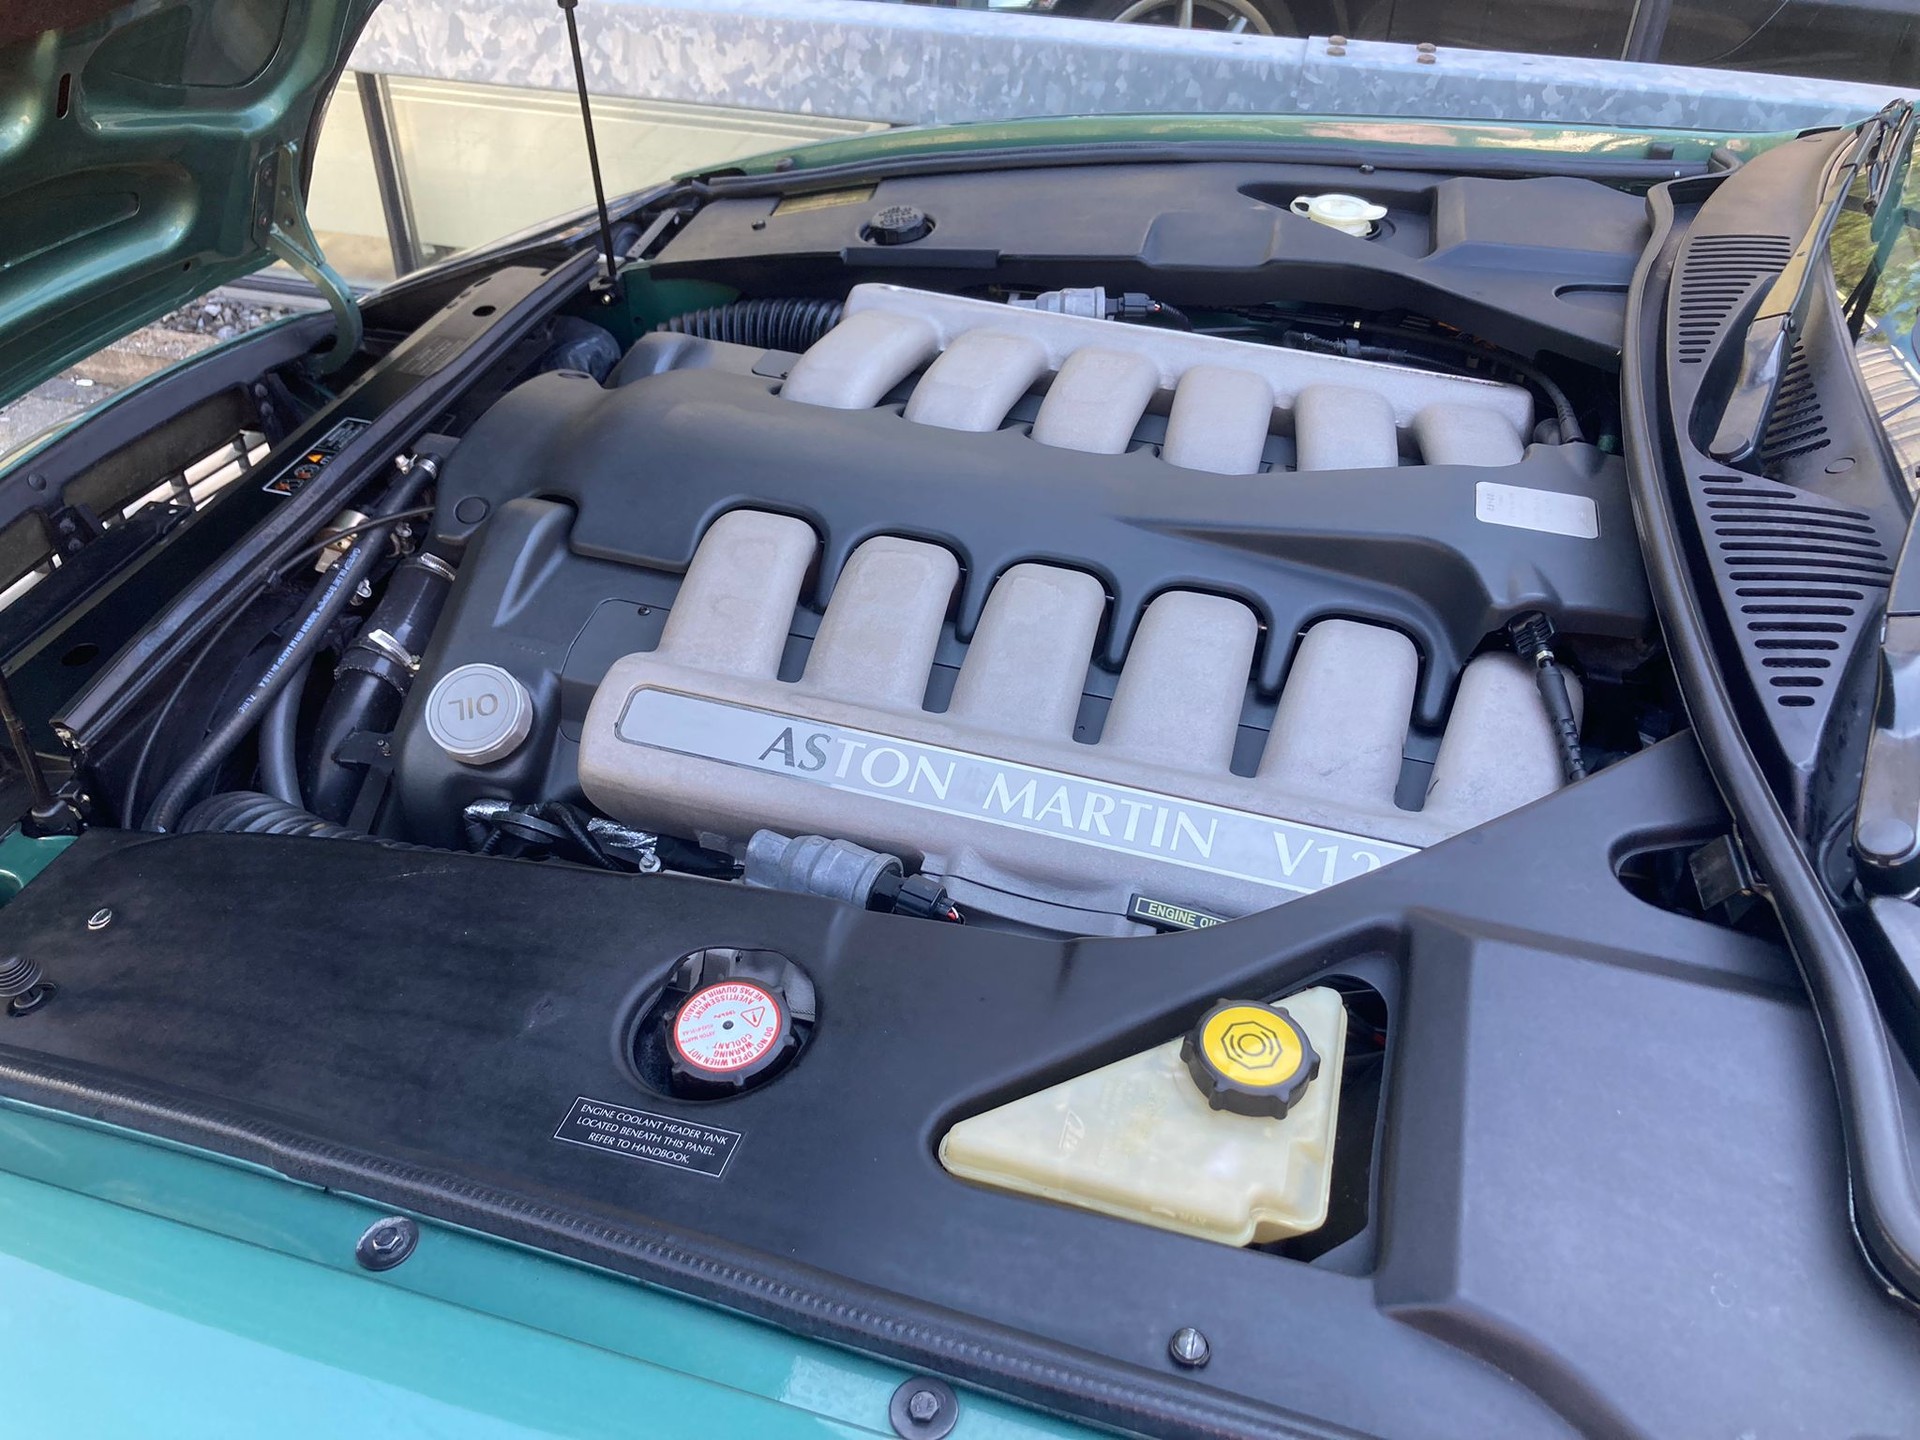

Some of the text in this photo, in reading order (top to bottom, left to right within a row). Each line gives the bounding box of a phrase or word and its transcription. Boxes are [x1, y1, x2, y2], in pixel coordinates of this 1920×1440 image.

[448, 693, 498, 720] OIL
[758, 727, 956, 800] ASTON
[982, 773, 1218, 859] MARTIN
[1148, 903, 1196, 925] ENGINE
[709, 986, 737, 997] OUVRIR
[740, 987, 754, 997] PAS
[682, 1001, 702, 1021] CHAUD
[693, 994, 754, 1019] AVERTISSEMENT
[688, 1026, 773, 1066] DO NOT OPEN WHEN HOT
[712, 1033, 752, 1049] COOLANT
[714, 1043, 754, 1058] WARNING
[577, 1116, 715, 1156] LOCATED BENEATH THIS PANEL.
[580, 1104, 728, 1145] ENGINE COOLANT HEADER TANK
[588, 1132, 689, 1164] REFER TO HANDBOOK.
